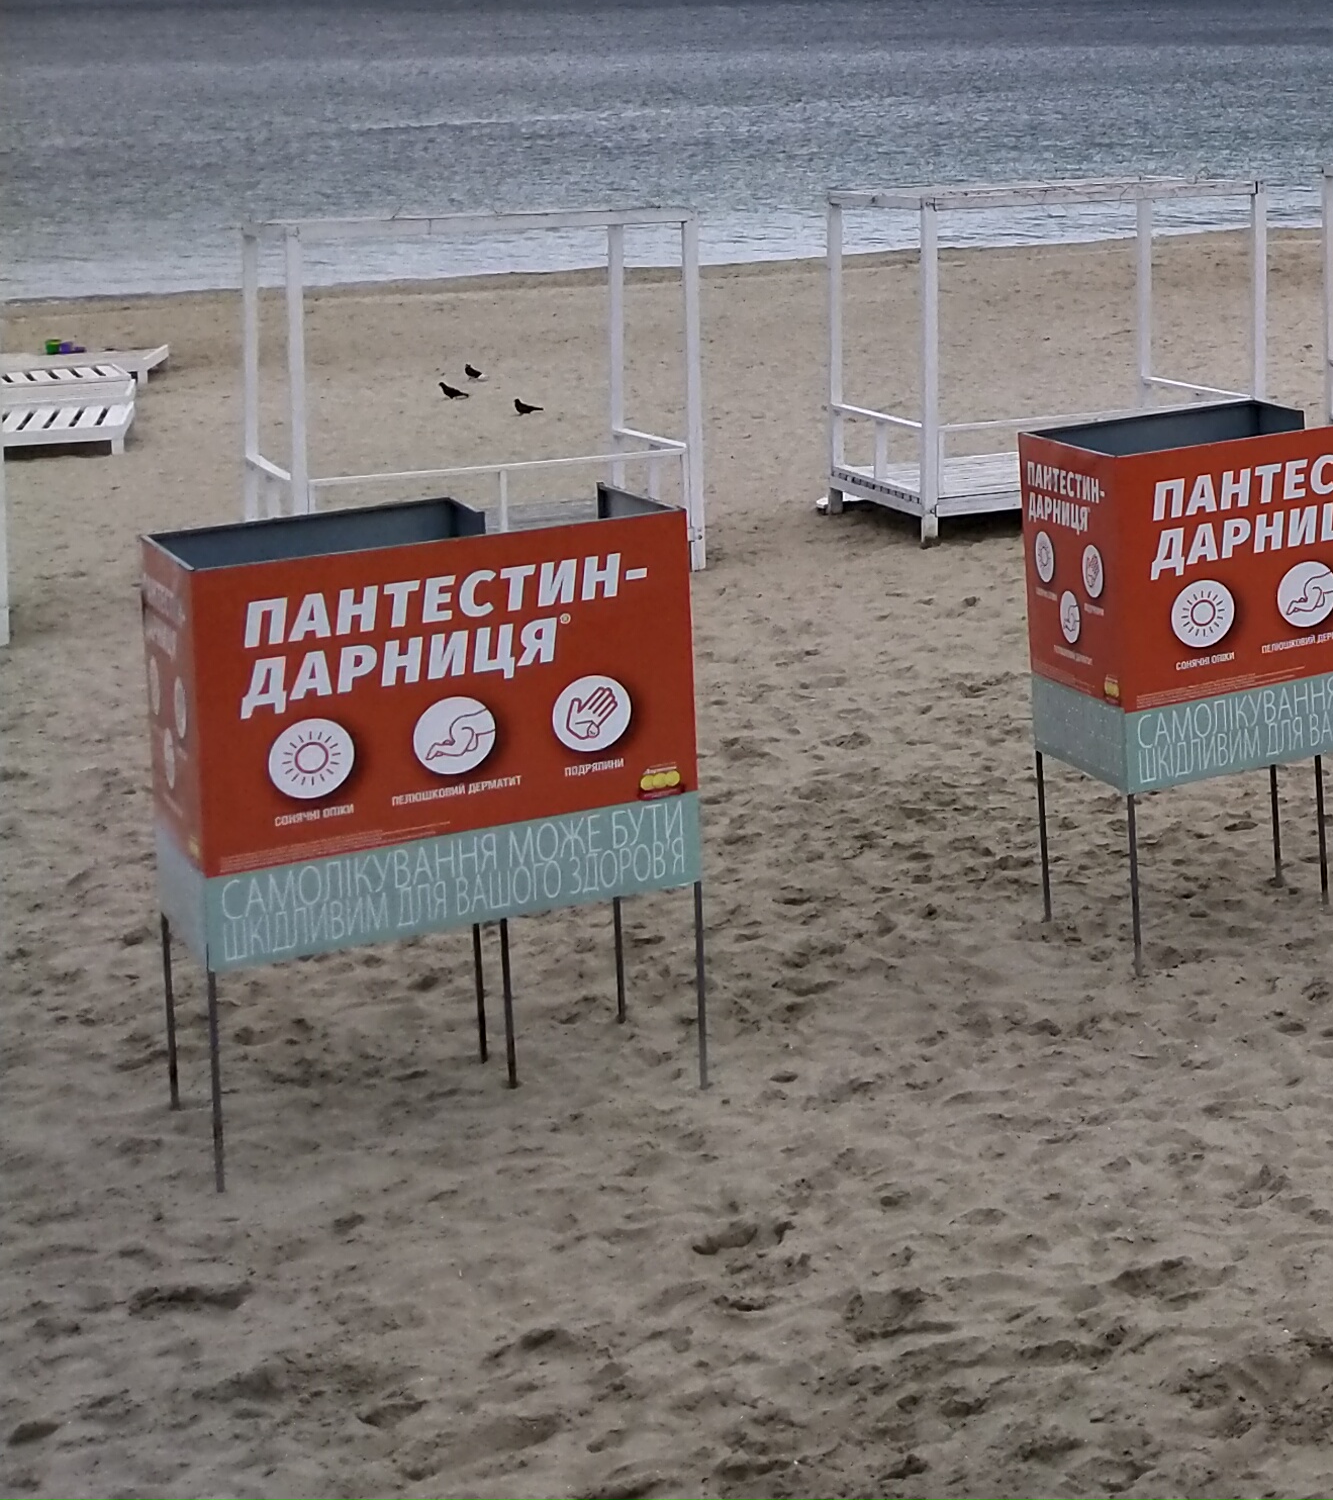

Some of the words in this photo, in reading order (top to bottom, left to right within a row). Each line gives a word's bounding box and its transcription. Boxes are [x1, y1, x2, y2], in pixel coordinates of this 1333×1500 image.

[244, 553, 648, 648] ПАНТЕСТИН-
[468, 775, 523, 795] ДЕРМАТИТ
[1138, 726, 1261, 784] ШКІДЛИВИМ
[1265, 716, 1303, 757] ДЛЯ
[221, 833, 497, 920] САМОЛІКУВАННЯ
[509, 814, 602, 867] МОЖЕ
[611, 800, 684, 849] БУТИ
[223, 892, 389, 962] ШКІДЛИВИМ
[396, 880, 448, 927] ДЛЯ
[456, 860, 562, 916] ВАШОГО
